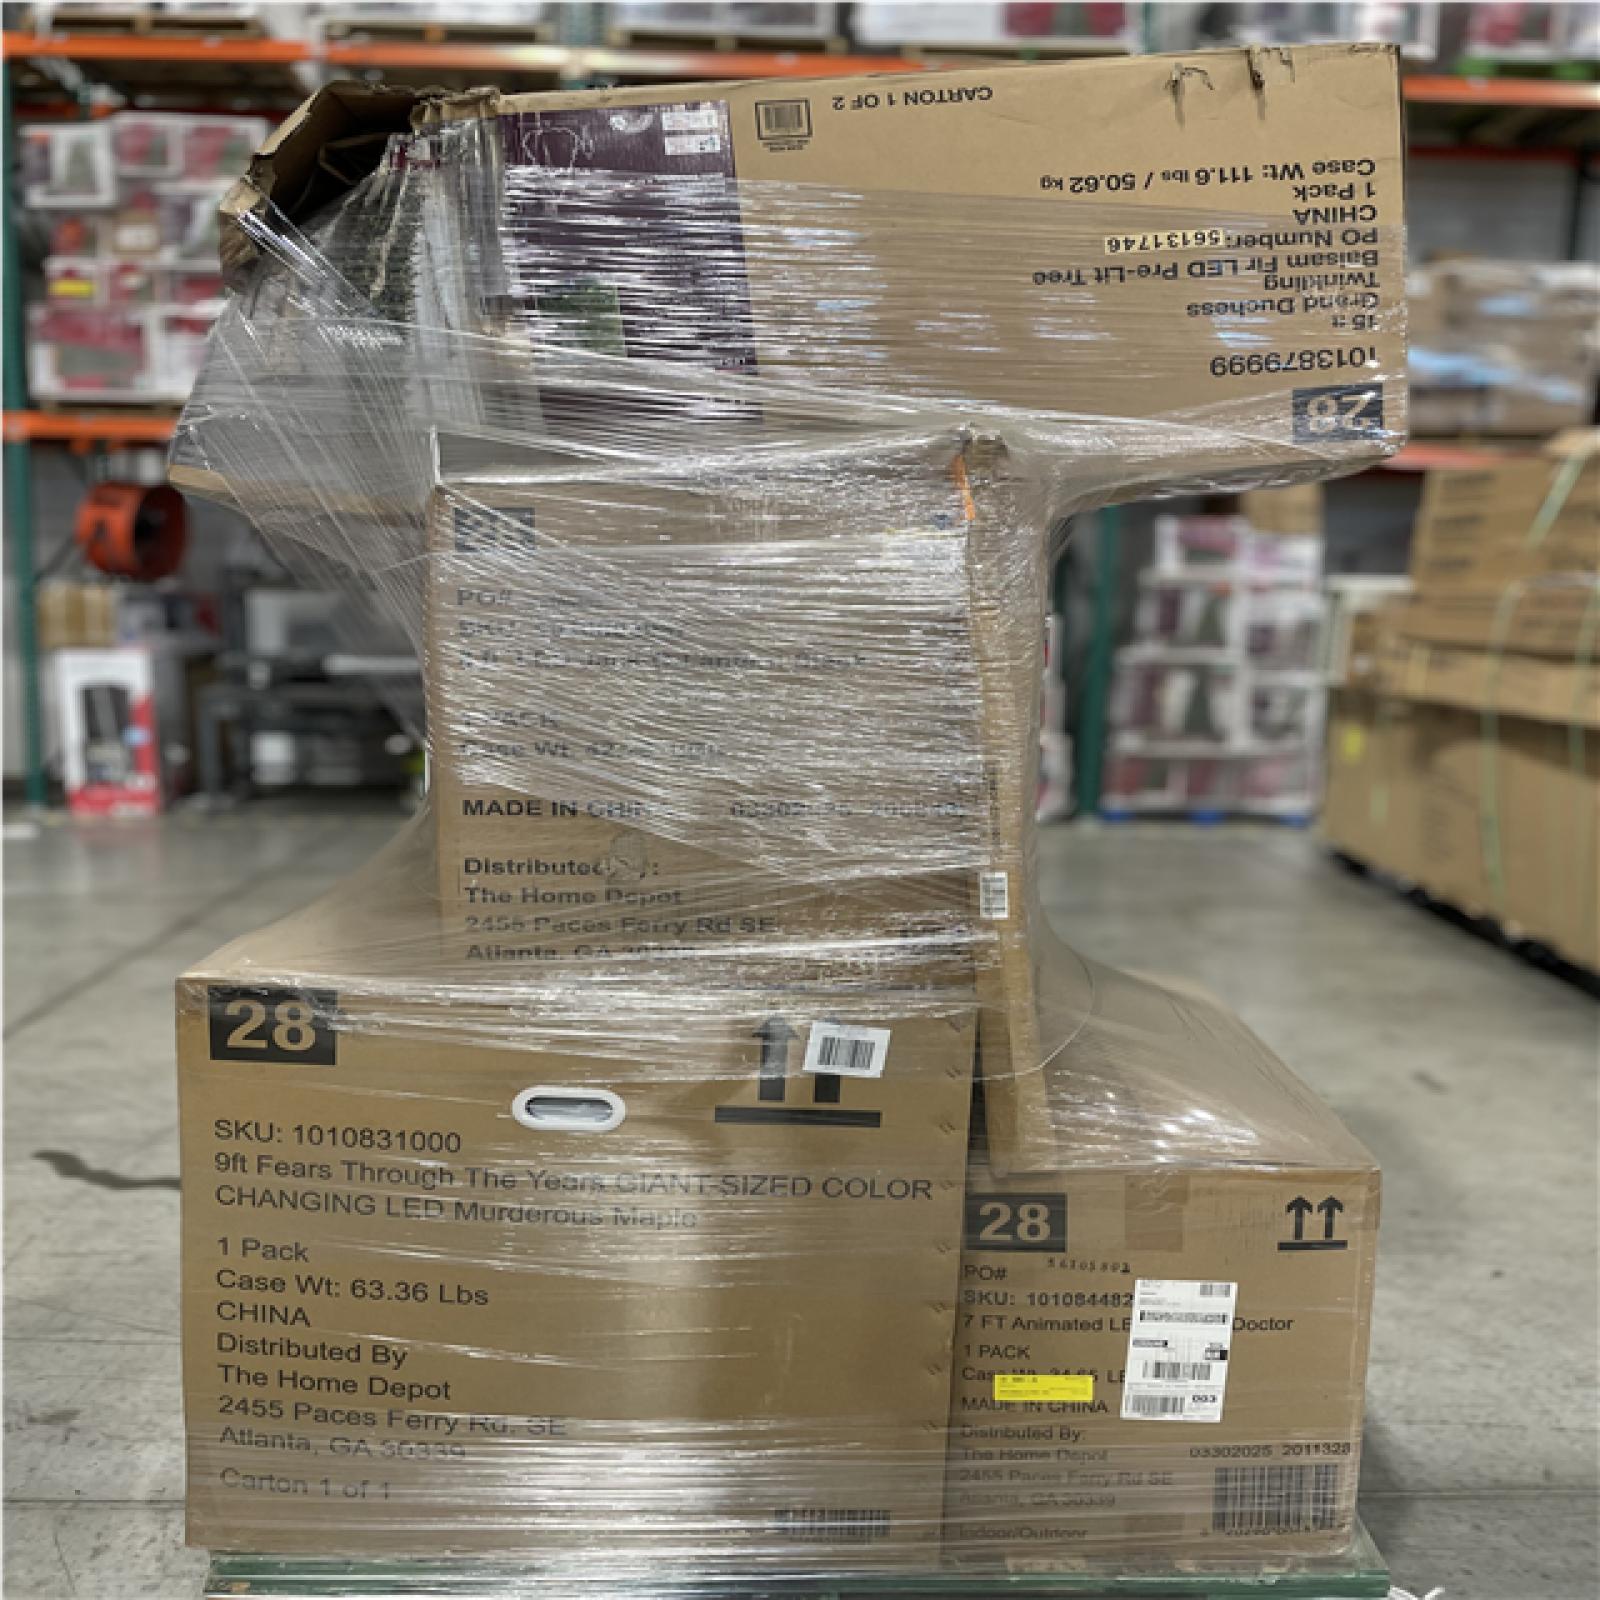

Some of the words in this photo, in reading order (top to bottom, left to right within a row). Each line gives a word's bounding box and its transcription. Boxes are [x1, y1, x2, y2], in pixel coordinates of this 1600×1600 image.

[832, 96, 845, 110] 2
[852, 93, 880, 110] OF
[888, 92, 897, 106] 1
[904, 87, 993, 105] CARTON
[1162, 169, 1190, 183] lbs
[1194, 166, 1253, 185] 111.6
[1262, 162, 1305, 180] Wt:
[1311, 159, 1376, 176] Case
[1040, 174, 1064, 191] kg
[1069, 172, 1136, 194] 50.62
[1143, 172, 1154, 189] /
[1366, 182, 1376, 198] 1
[1292, 182, 1355, 202] Pack
[1292, 204, 1378, 225] CHINA
[1107, 229, 1220, 252] 56131746
[1226, 231, 1333, 250] Number:
[1342, 227, 1379, 247] PO
[1094, 262, 1178, 284] Pre-Lit
[1187, 259, 1239, 278] LED
[1249, 255, 1279, 273] Fir
[1032, 267, 1087, 286] Tree
[1264, 271, 1380, 292] Twinkling
[1186, 296, 1295, 318] Duchess
[1210, 347, 1376, 377] 1013879999
[1306, 391, 1376, 433] 28
[462, 799, 543, 816] MADE
[551, 800, 579, 817] IN
[465, 886, 511, 904] The
[522, 887, 596, 904] Home
[223, 998, 317, 1051] 28
[214, 1119, 283, 1144] SKU:
[293, 1124, 462, 1154] 1010831000
[214, 1152, 248, 1173] 9ft
[257, 1154, 332, 1180] Fears
[341, 1160, 456, 1190] Through
[465, 1167, 517, 1190] The
[821, 1176, 934, 1200] COLOR
[215, 1184, 376, 1216] CHANGING
[386, 1196, 444, 1219] LED
[454, 1201, 603, 1227] Murderous
[979, 1201, 1051, 1243] 28
[217, 1237, 229, 1255] 1
[241, 1237, 310, 1263] Pack
[963, 1264, 1008, 1281] PO#
[216, 1268, 286, 1292] Case
[295, 1274, 341, 1298] Wt:
[351, 1279, 429, 1302] 63.36
[438, 1283, 489, 1306] Lbs
[963, 1289, 1016, 1306] SKU:
[1027, 1291, 1134, 1308] 101084482
[216, 1300, 311, 1328] CHINA
[963, 1314, 975, 1329] 7
[982, 1314, 1008, 1329] FT
[1012, 1316, 1103, 1331] Animated
[1109, 1317, 1133, 1331] LE
[1232, 1316, 1296, 1331] Doctor
[216, 1332, 361, 1364] Distributed
[371, 1345, 408, 1371] By
[964, 1344, 972, 1358] 1
[979, 1344, 1031, 1360] PACK
[217, 1364, 269, 1387] The
[278, 1369, 358, 1395] Home
[368, 1377, 451, 1402] Depot
[218, 1395, 285, 1419] 2455
[293, 1402, 377, 1427] Paces
[387, 1409, 458, 1435] Ferry
[1047, 1399, 1109, 1414] CHINA
[219, 1426, 319, 1456] Atlanta,
[220, 1467, 309, 1496] Carton
[320, 1478, 330, 1497] 1
[342, 1480, 370, 1499] of
[380, 1481, 391, 1500] 1
